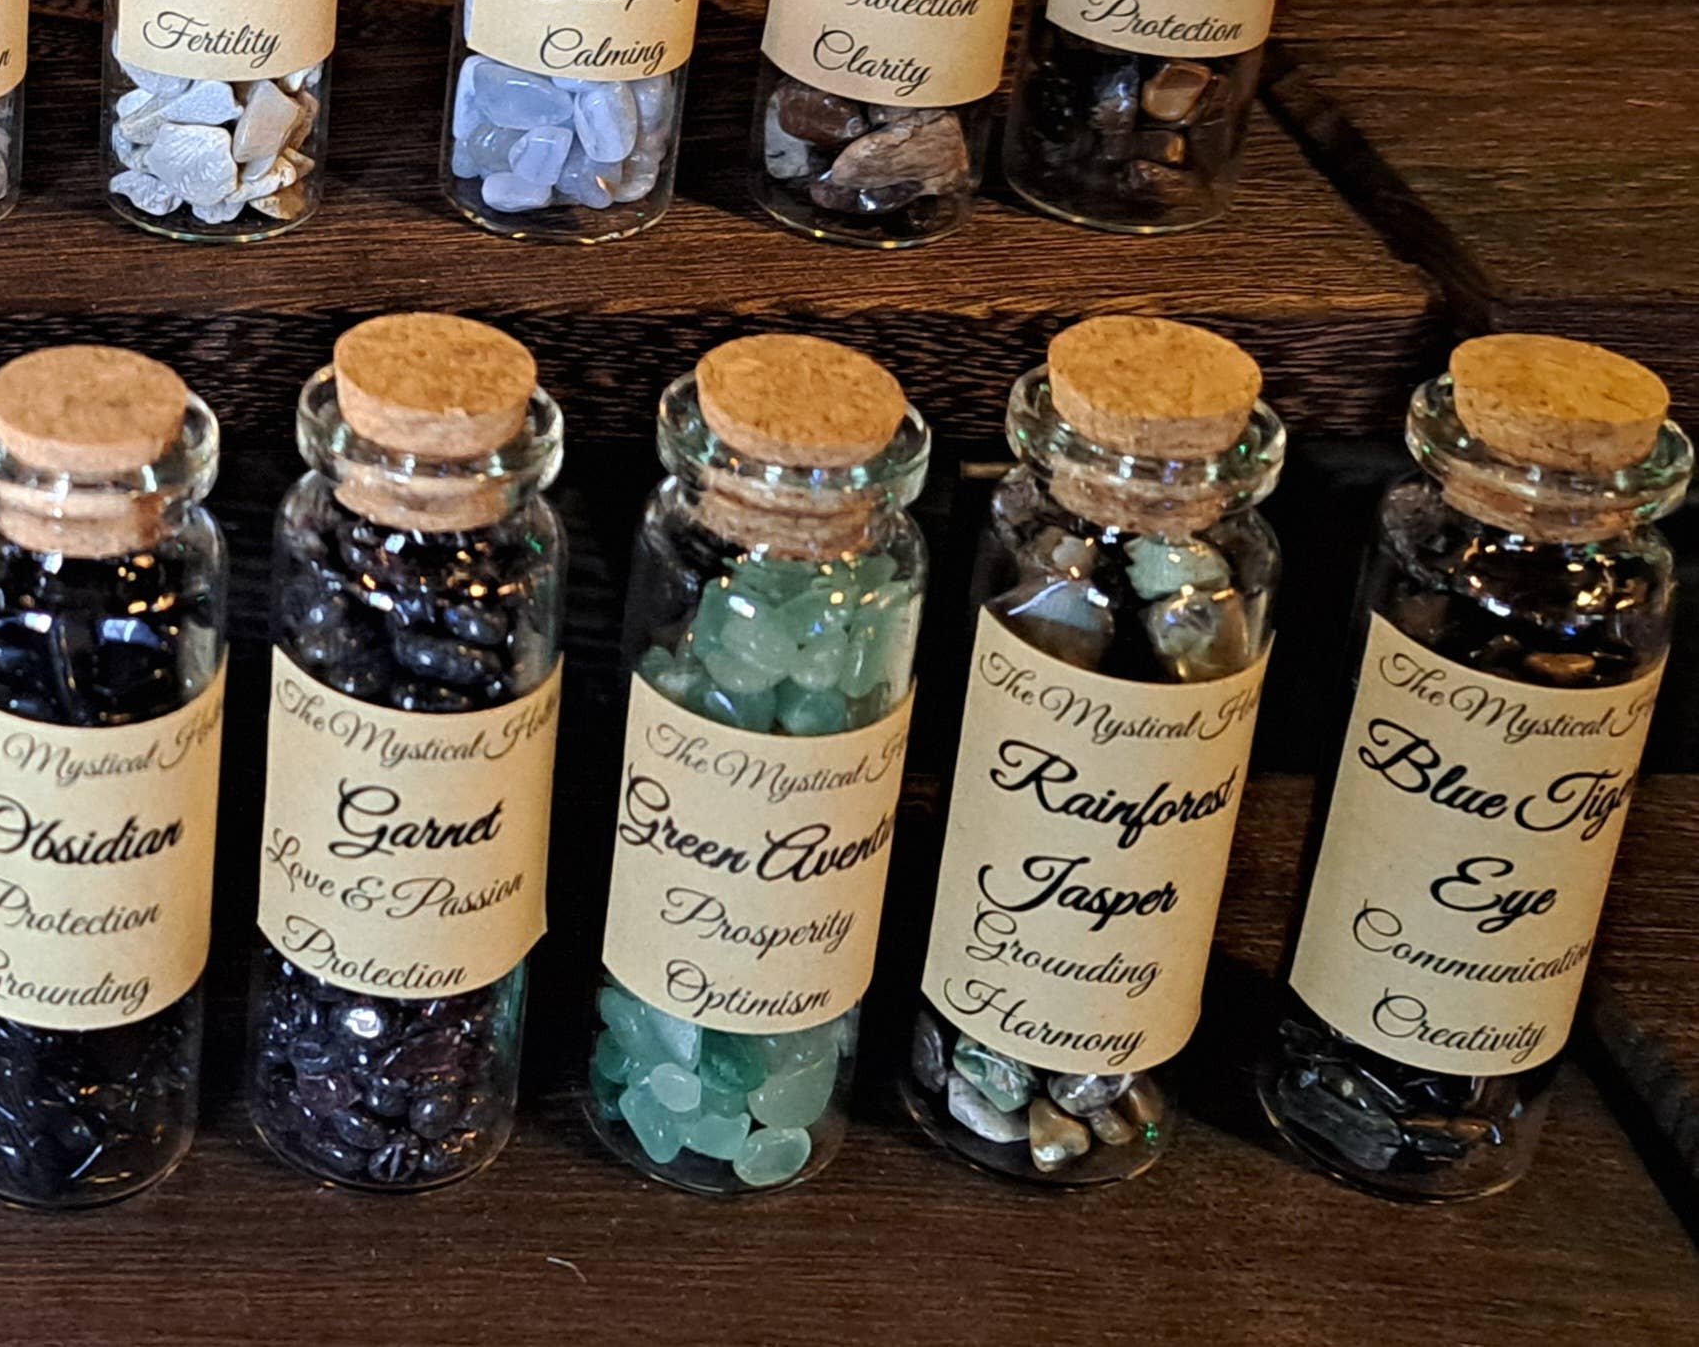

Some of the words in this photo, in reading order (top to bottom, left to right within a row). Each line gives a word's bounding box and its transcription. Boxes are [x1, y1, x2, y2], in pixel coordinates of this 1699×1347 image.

[143, 10, 281, 69] Fertility
[540, 24, 668, 76] Calming
[813, 22, 933, 97] Clarity
[1039, 687, 1200, 742] Mystical
[1379, 652, 1444, 708] The
[1449, 684, 1613, 744] Mystical
[2, 733, 163, 787] Mystical
[328, 713, 486, 768] Mystical
[713, 751, 866, 803] Mystical
[1358, 718, 1508, 820] Blue
[328, 777, 504, 857] Garnet
[619, 762, 748, 875] Green
[989, 739, 1236, 848] Rainforest
[265, 826, 335, 900] Love
[341, 877, 386, 913] &
[386, 872, 525, 921] Passion
[977, 856, 1178, 932] Jasper
[1429, 857, 1558, 934] Eye
[282, 915, 467, 989] Protection
[660, 887, 857, 962] Prosperity
[965, 900, 1163, 998] Grounding
[665, 958, 833, 1019] Optimism
[943, 976, 1145, 1067] Harmony
[1372, 987, 1547, 1065] Creativity
